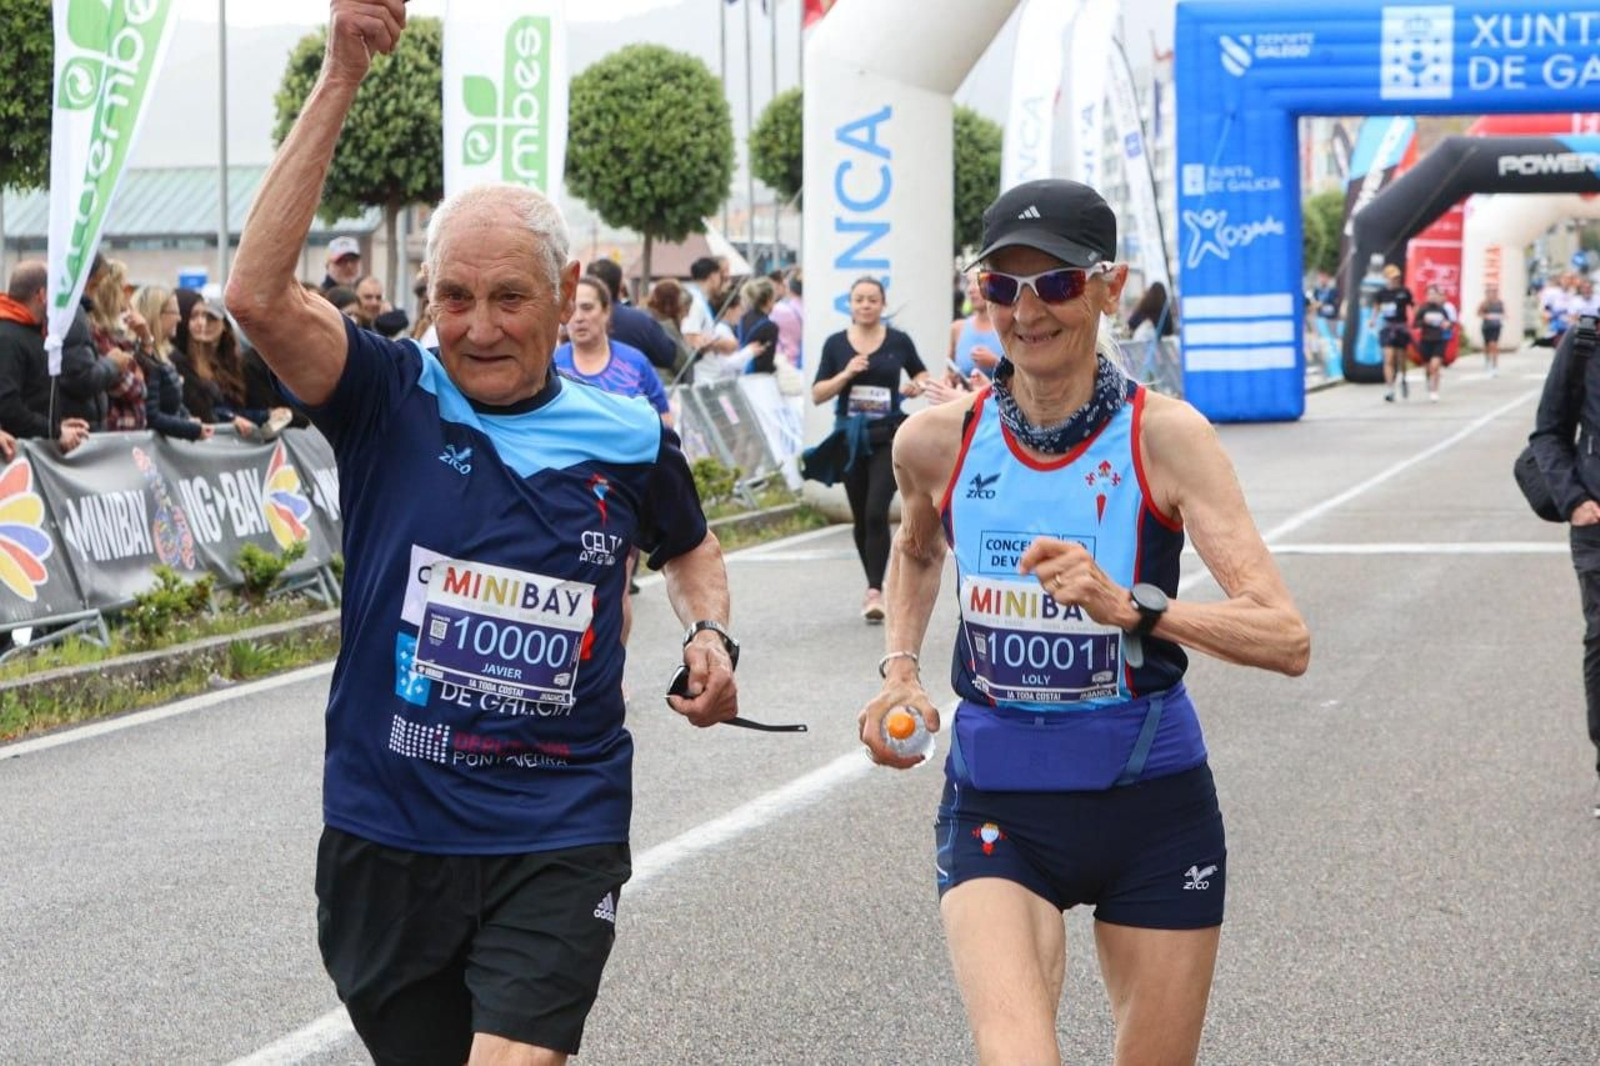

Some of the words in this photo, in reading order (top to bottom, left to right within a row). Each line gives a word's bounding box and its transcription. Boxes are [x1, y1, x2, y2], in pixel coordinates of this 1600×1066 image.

[1256, 32, 1315, 45] DEPORTE
[1470, 11, 1600, 49] XUNT
[1468, 55, 1527, 90] DE
[507, 25, 542, 183] mbes
[1206, 180, 1225, 192] DE
[1227, 177, 1282, 192] GALICIA
[1208, 165, 1253, 178] XUNTA
[66, 490, 153, 562] MINIBAY
[991, 555, 1007, 567] DE
[443, 566, 582, 617] MINIBAY
[970, 585, 1083, 621] MINIBA
[453, 615, 569, 668] 10000
[988, 632, 1094, 670] 10001
[481, 663, 522, 680] JAVIER
[1022, 674, 1051, 686] LOLY
[440, 681, 471, 708] DE
